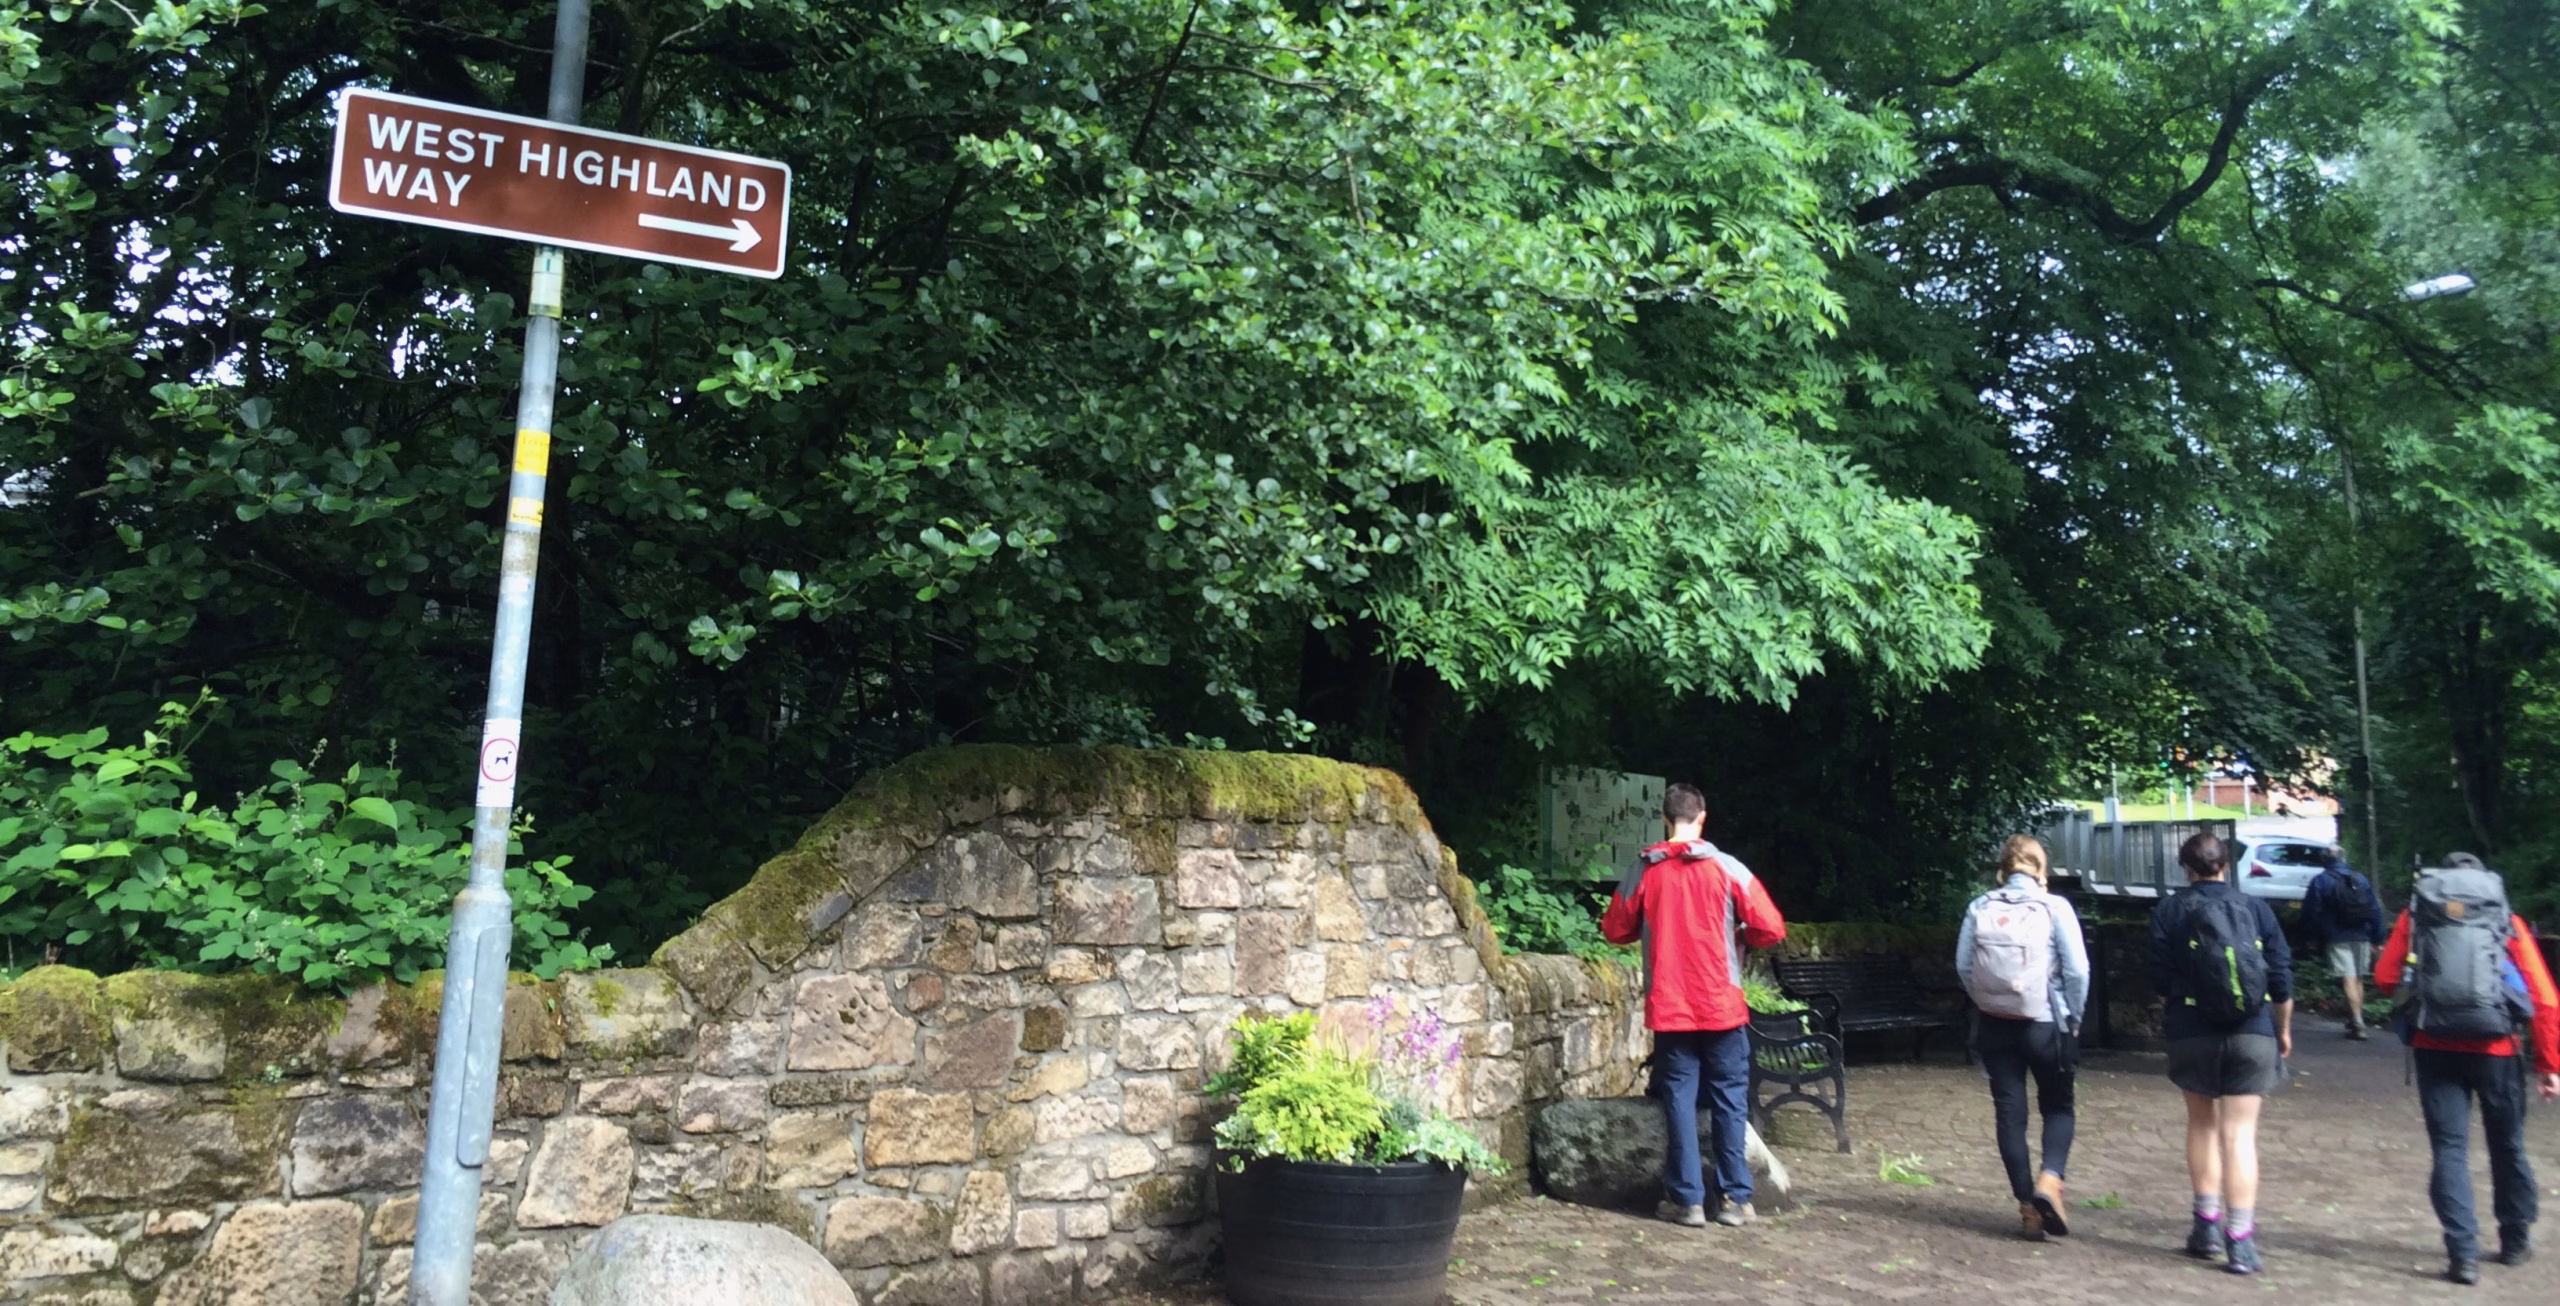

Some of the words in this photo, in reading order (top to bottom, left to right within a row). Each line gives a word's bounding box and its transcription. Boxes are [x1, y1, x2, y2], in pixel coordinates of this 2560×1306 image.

[363, 157, 471, 207] WAY
[368, 113, 504, 168] WEST
[519, 139, 766, 213] HIGHLAND
